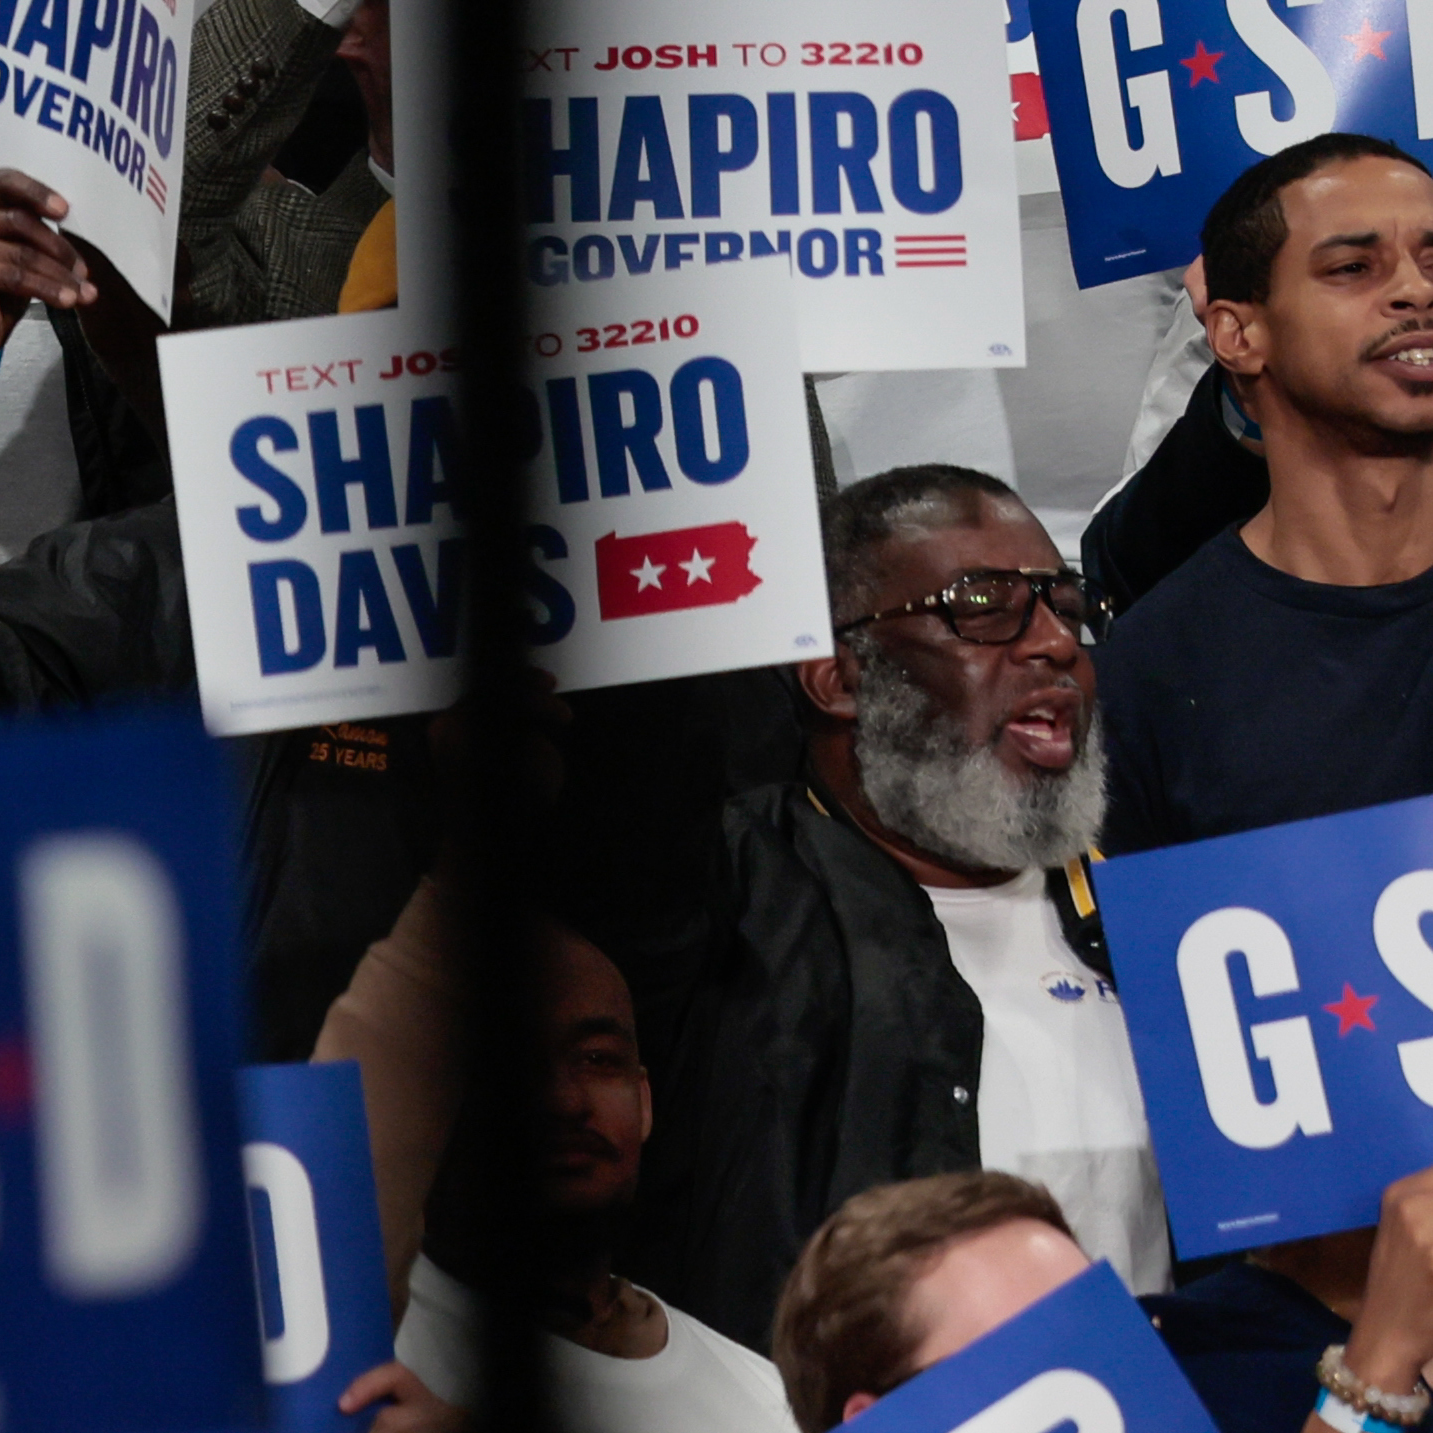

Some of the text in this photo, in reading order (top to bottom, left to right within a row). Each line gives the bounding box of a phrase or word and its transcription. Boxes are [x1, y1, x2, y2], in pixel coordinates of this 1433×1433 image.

[594, 44, 718, 71] JOSH
[732, 42, 787, 66] TO
[800, 42, 924, 67] 32210
[523, 87, 964, 224] HAPIRO
[256, 360, 364, 394] TEXT
[379, 349, 466, 381] JOS
[576, 314, 700, 353] 32210
[247, 524, 577, 677] DAVS
[309, 743, 388, 771] 25 YEARS
